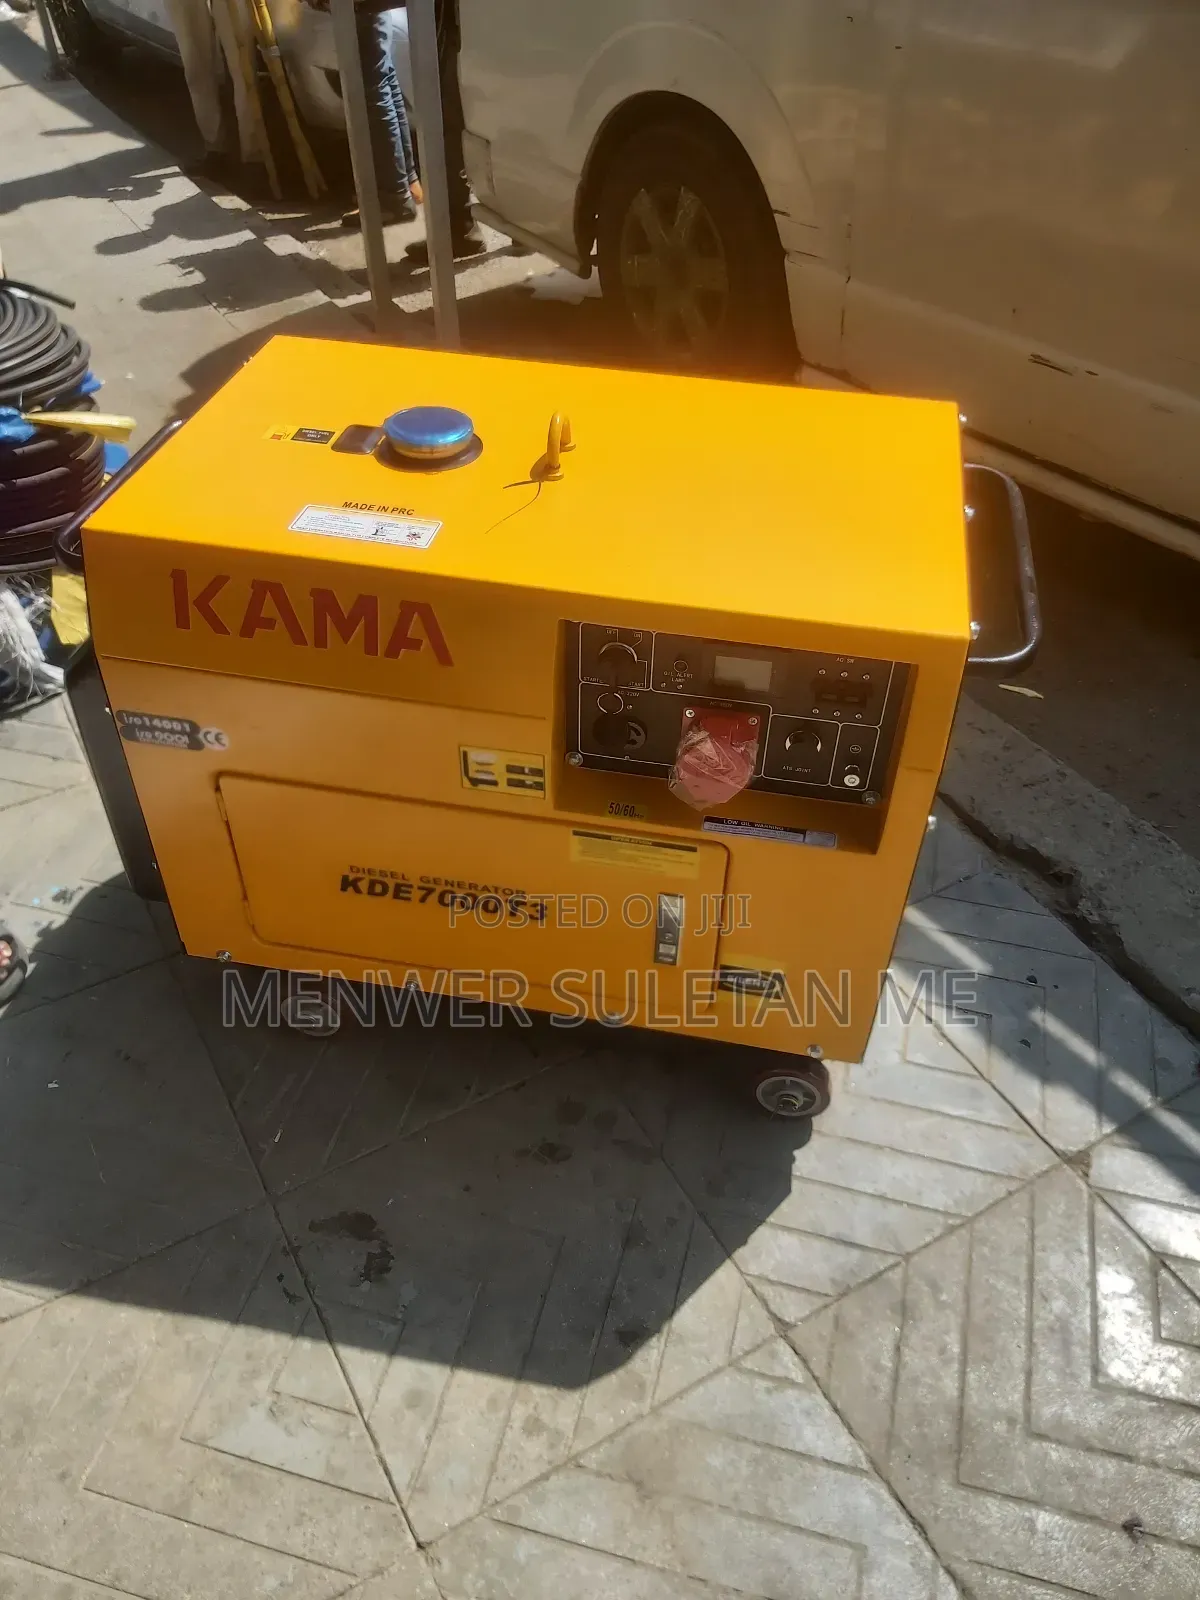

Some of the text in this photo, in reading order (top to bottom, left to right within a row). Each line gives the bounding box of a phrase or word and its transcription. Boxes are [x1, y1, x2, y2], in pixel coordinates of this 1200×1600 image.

[341, 501, 415, 516] MADE IN PRC
[170, 568, 455, 667] KAMA
[754, 823, 784, 831] WARNING
[348, 865, 526, 897] DIESEL GENERATOR
